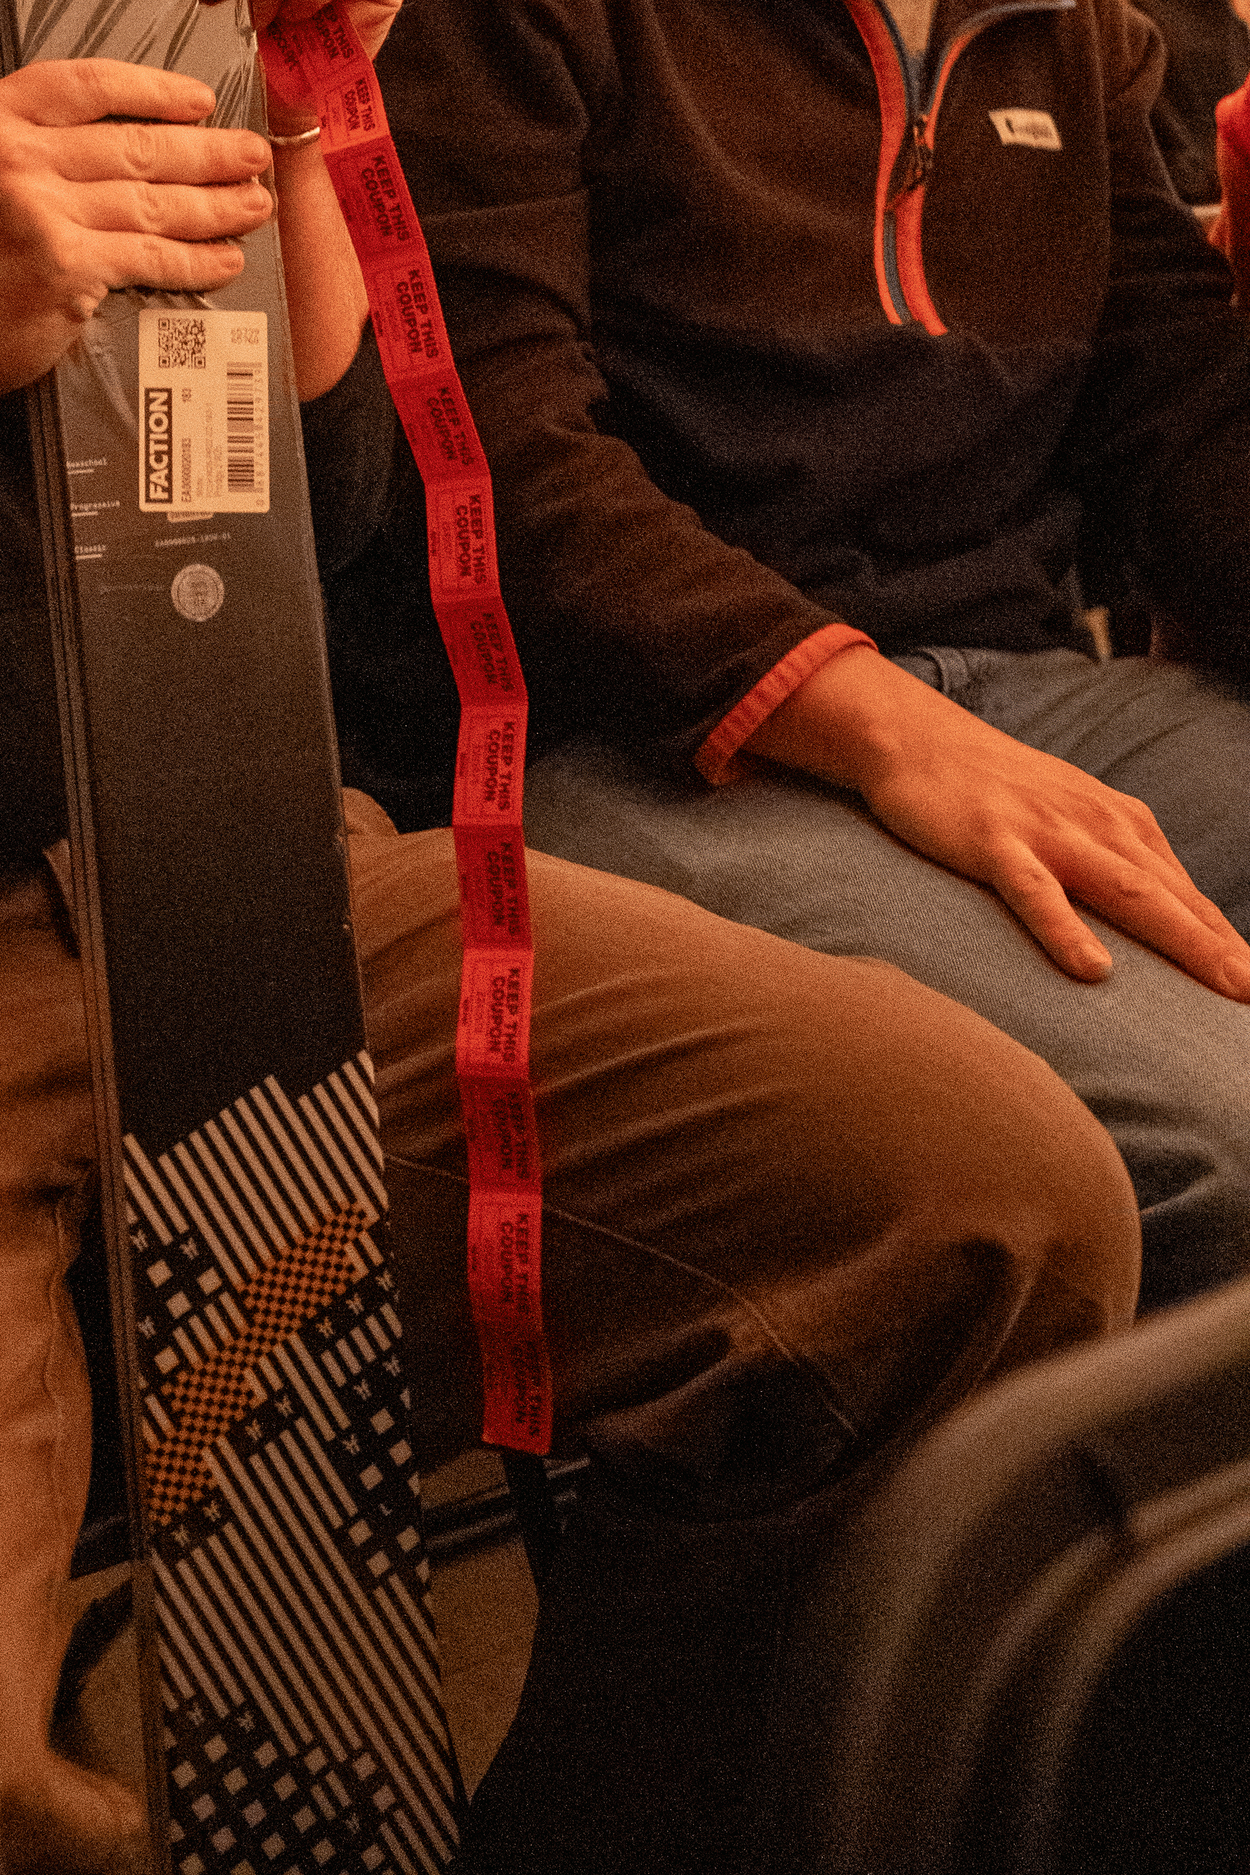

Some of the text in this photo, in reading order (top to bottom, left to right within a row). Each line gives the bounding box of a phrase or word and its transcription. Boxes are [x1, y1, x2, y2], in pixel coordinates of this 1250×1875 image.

[313, 11, 339, 60] OUPON
[332, 26, 355, 59] THIS
[343, 89, 361, 131] COUPON
[355, 78, 376, 132] KEEP THIS
[361, 166, 394, 237] COUPON
[373, 155, 411, 242] KEEP THIS
[396, 281, 423, 354] COUPON
[408, 269, 439, 359] KEEP THIS
[148, 391, 169, 500] FACTION
[427, 397, 458, 461] COUPON
[437, 386, 475, 466] KEEP THIS
[71, 500, 120, 512] Progressive
[455, 505, 471, 577] COUPON
[468, 494, 486, 585] KEEP THIS
[75, 544, 106, 553] Classic
[470, 620, 497, 685] COUPON
[481, 612, 514, 692] KEEP THIS
[484, 729, 501, 802] COUPON
[498, 721, 515, 812] KEEP THIS
[487, 850, 505, 927] COUPON
[500, 841, 521, 936] KEEP THIS
[489, 976, 506, 1053] COUPON
[502, 967, 520, 1064] KEEP THIS
[492, 1098, 514, 1170] COUPON
[515, 1139, 531, 1180] THIS
[500, 1221, 514, 1304] COUPON
[516, 1212, 530, 1316] KEEP THIS
[528, 1394, 542, 1438] THIS
